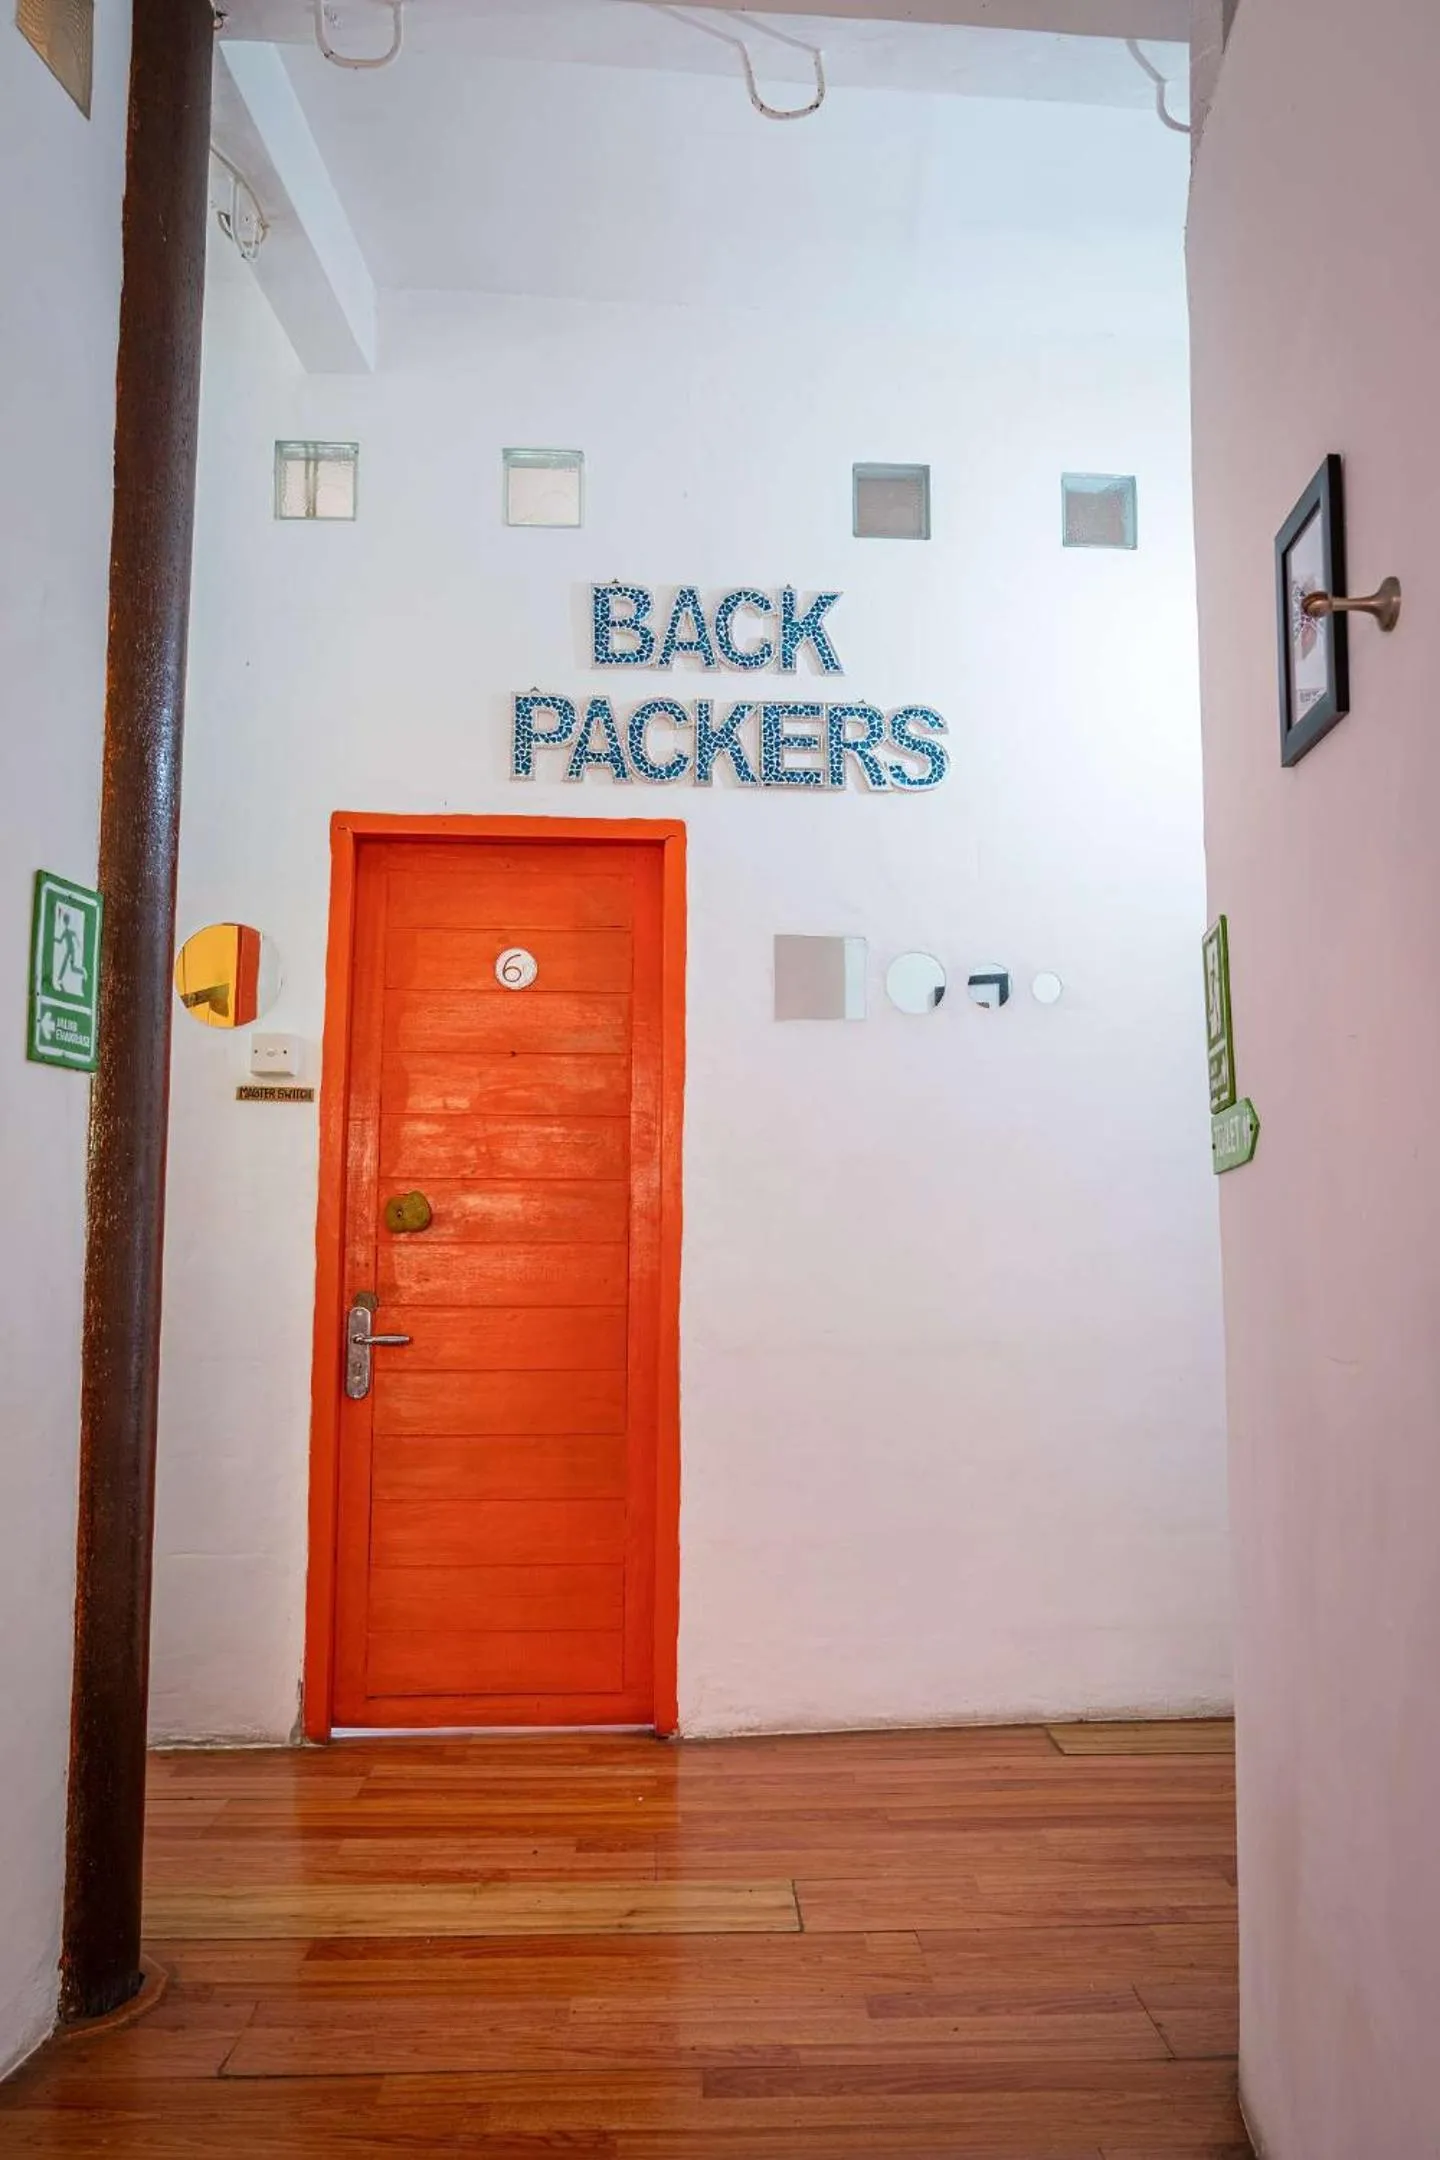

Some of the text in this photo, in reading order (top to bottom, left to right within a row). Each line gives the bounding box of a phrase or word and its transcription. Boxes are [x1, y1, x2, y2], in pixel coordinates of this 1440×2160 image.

[590, 582, 845, 676] BACK
[511, 688, 951, 791] PACKERS
[502, 953, 522, 983] 6
[239, 1085, 275, 1100] MASTER
